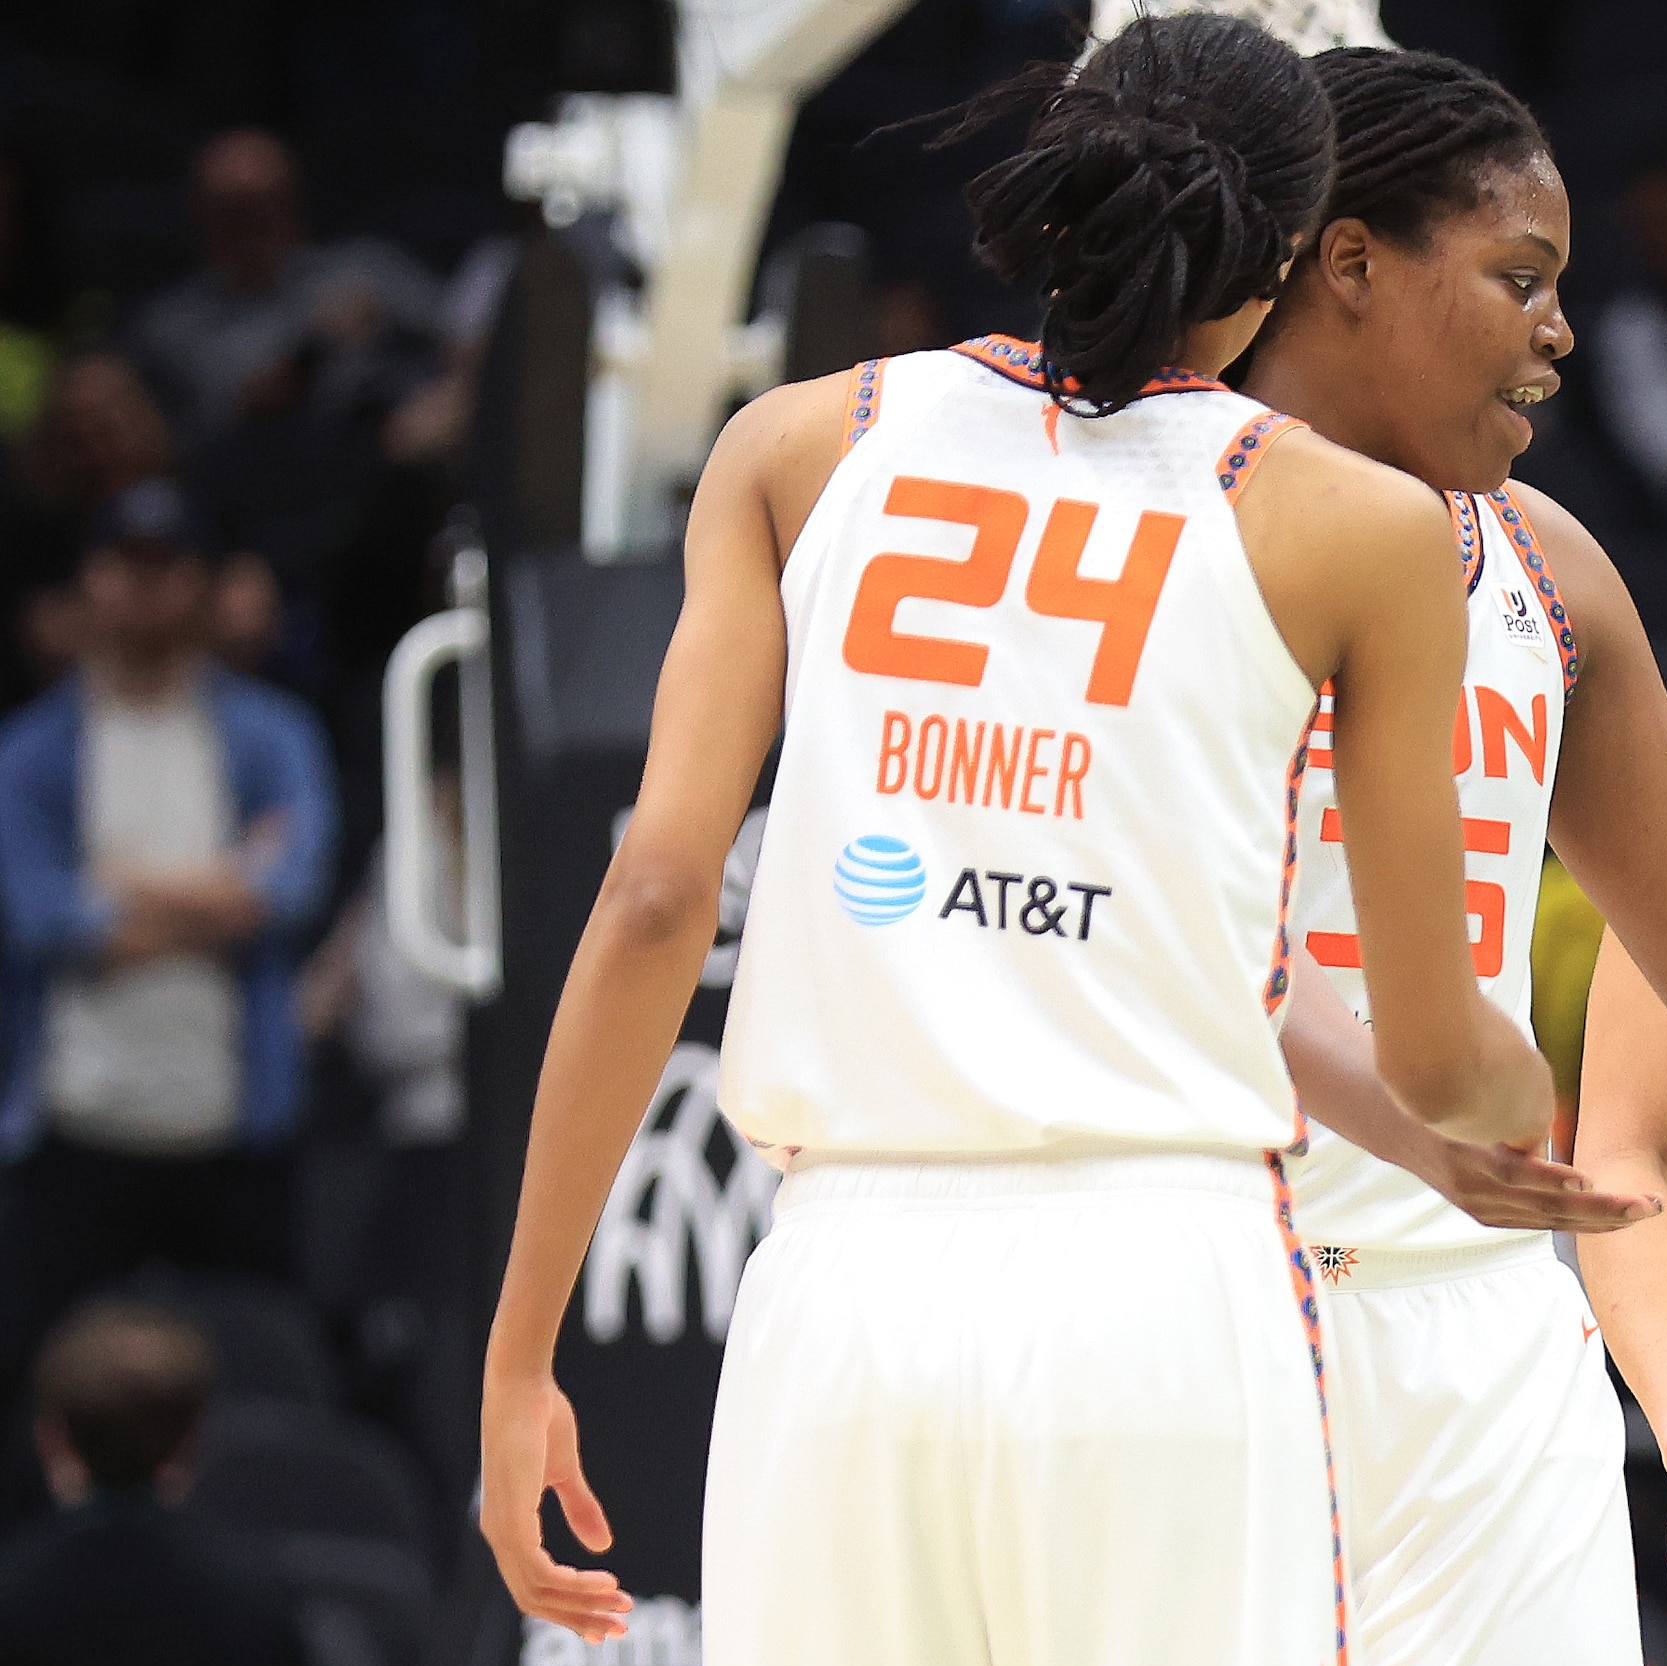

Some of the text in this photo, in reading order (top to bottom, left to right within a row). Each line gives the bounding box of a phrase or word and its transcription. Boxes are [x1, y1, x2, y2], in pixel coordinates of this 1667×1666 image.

[842, 475, 1187, 707] 24
[1502, 613, 1540, 634] Post
[876, 710, 1092, 820] BONNER
[938, 867, 1113, 941] AT&T
